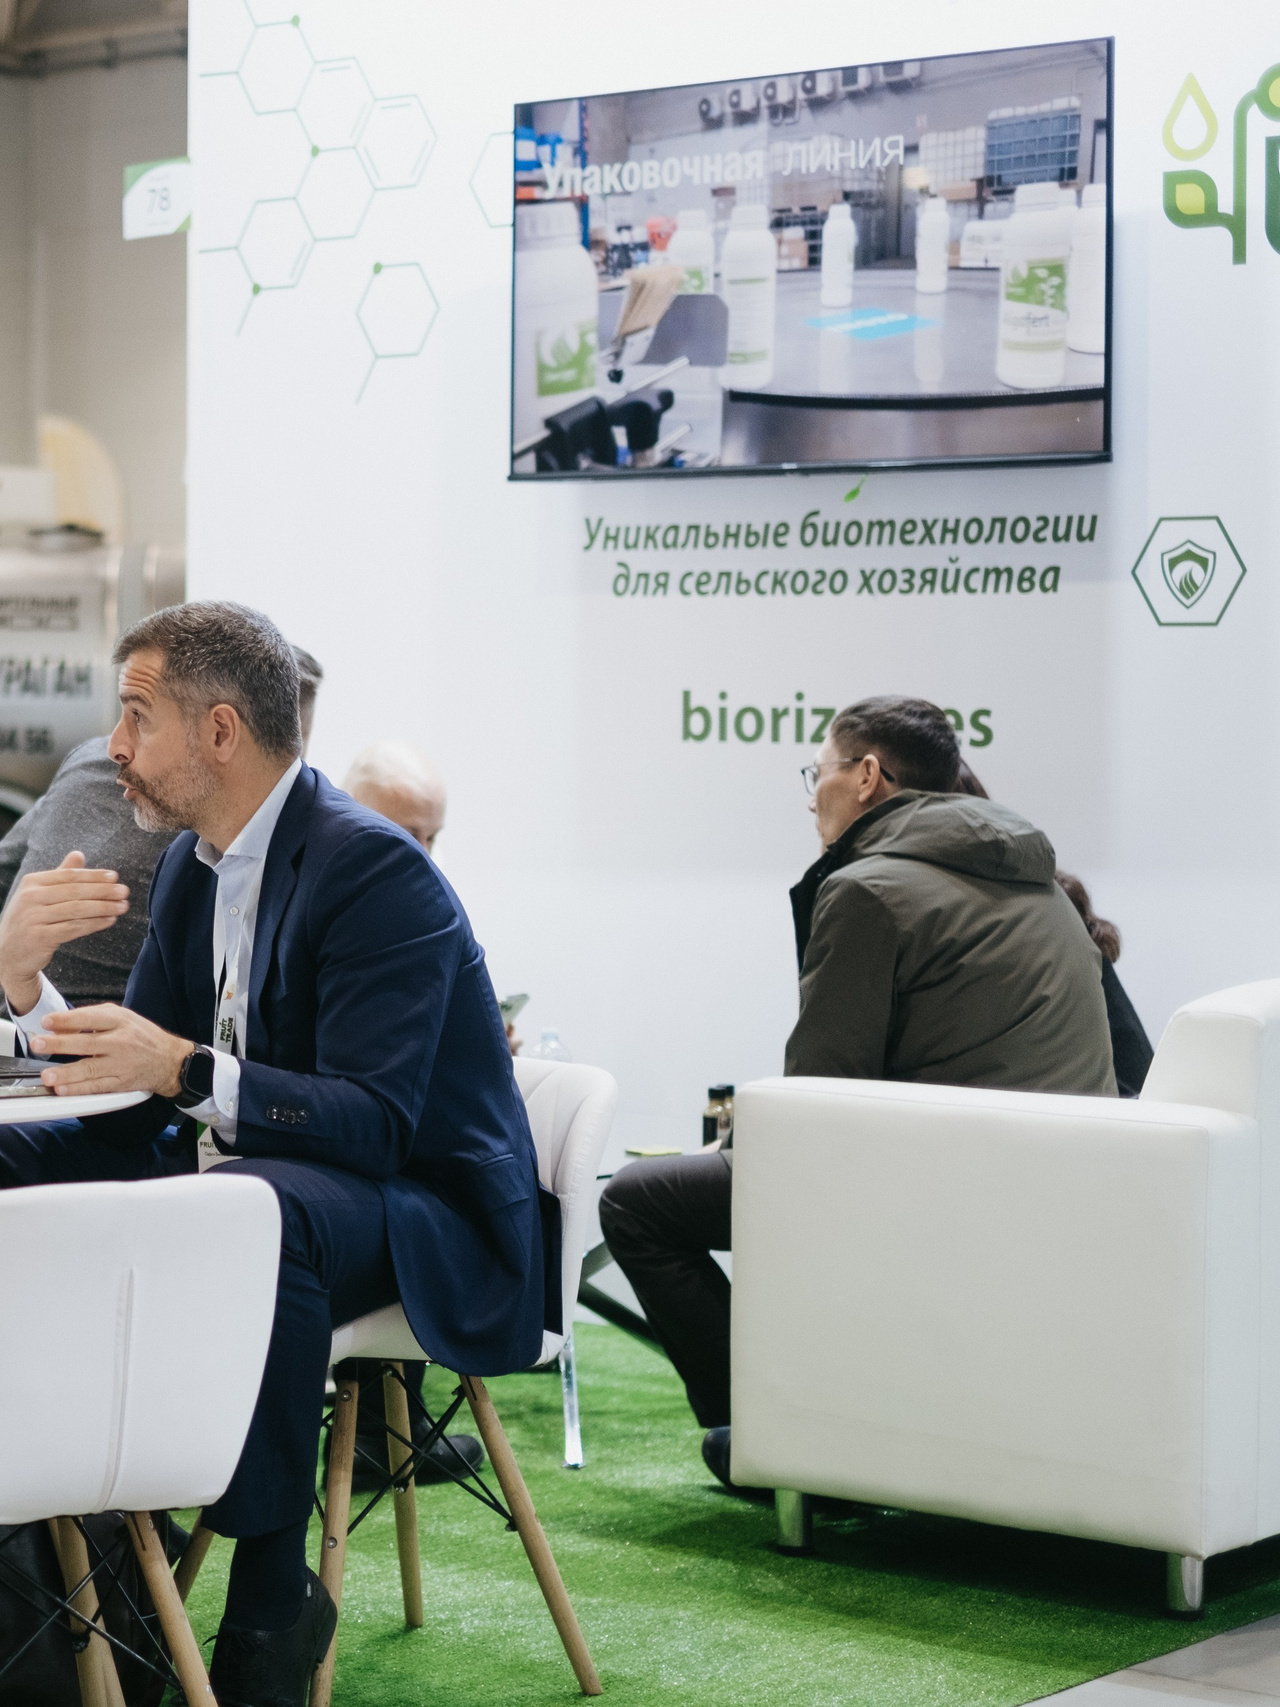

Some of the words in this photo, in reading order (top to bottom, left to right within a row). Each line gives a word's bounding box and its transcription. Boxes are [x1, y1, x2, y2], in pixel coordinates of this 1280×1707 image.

[543, 148, 766, 200] Упаковочная
[147, 186, 171, 212] 78
[583, 516, 791, 552] Уникальные
[799, 511, 1099, 548] биотехнологии
[612, 561, 670, 598] для
[678, 568, 849, 597] сельского
[856, 556, 1061, 596] хозяйства
